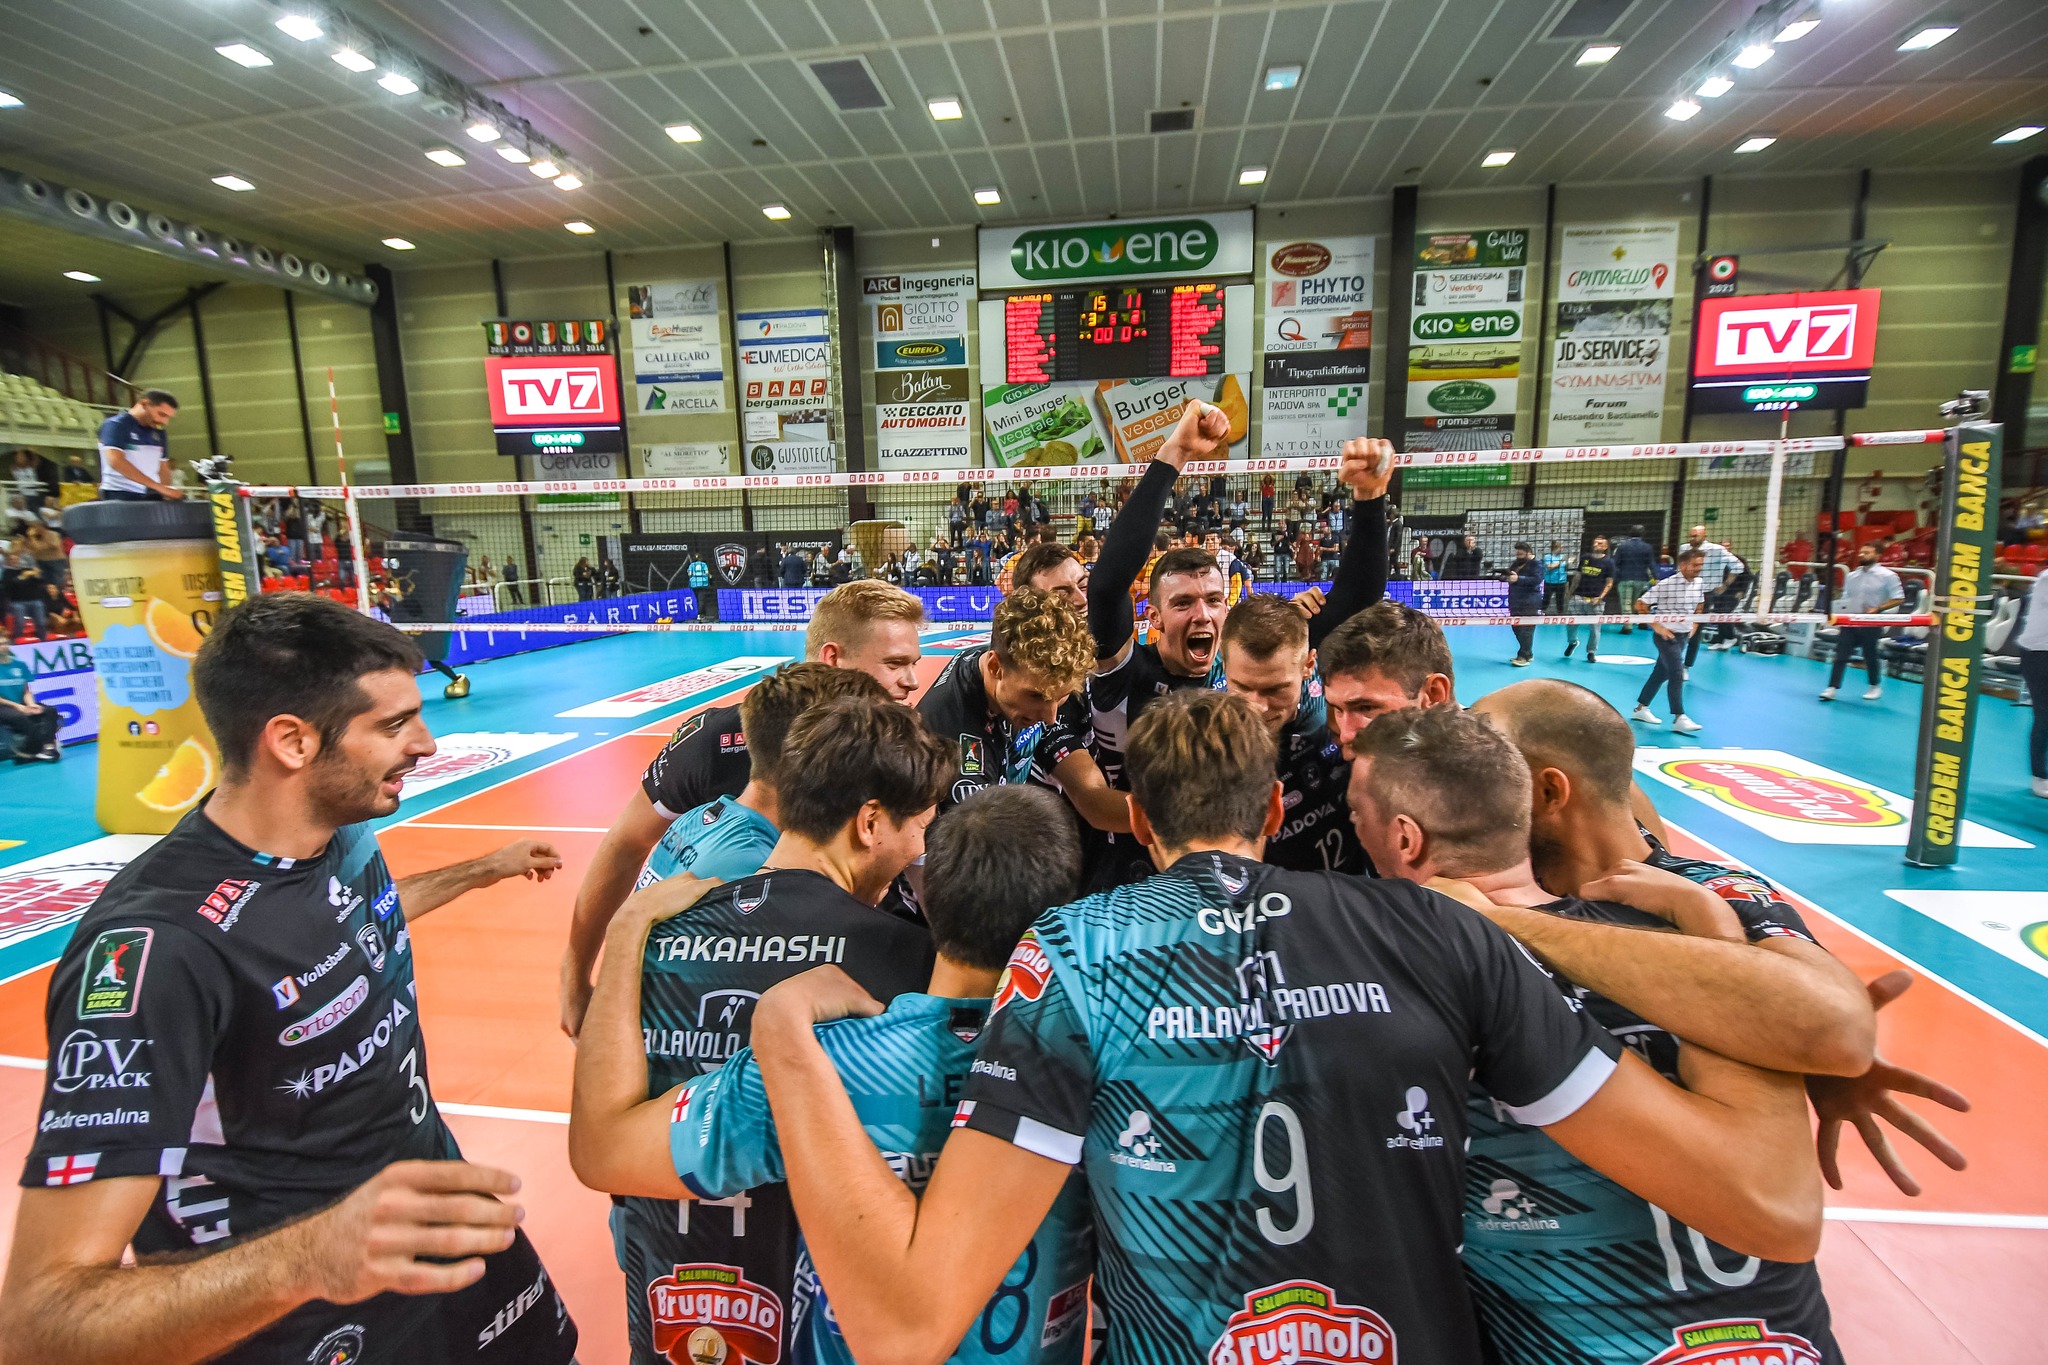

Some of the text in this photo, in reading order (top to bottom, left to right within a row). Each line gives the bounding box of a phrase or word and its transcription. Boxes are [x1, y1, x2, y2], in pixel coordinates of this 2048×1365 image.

[867, 274, 974, 292] ARC ingegneria
[1301, 276, 1365, 295] PHYTO
[1093, 295, 1107, 311] 15
[1127, 292, 1142, 309] 11
[1301, 293, 1365, 305] PERFORMANCE
[903, 301, 959, 316] GIOTTO
[909, 314, 954, 325] CELLINO
[1088, 312, 1097, 327] 3
[1726, 314, 1850, 356] TV7
[586, 344, 606, 352] 2016
[902, 346, 939, 354] EUREKA
[1266, 342, 1318, 351] CONQUEST
[645, 351, 710, 363] CALLEGARO
[748, 347, 827, 365] EUMEDICA
[508, 375, 597, 407] TV7
[747, 379, 827, 398] BAAP
[1269, 388, 1327, 399] INTERPORTO
[671, 398, 719, 409] ARCELLA
[746, 396, 825, 408] bergamaschi
[1114, 381, 1188, 420] Burger
[1269, 401, 1305, 410] PADOVA
[1585, 399, 1628, 408] Forum
[899, 405, 962, 417] CECCATO
[993, 394, 1067, 431] Mini Burger
[1553, 411, 1660, 421] Alessandro Bastianello
[881, 416, 966, 429] AUTOMOBILI
[1122, 403, 1185, 438] vegetal
[1000, 416, 1054, 445] vegetale
[881, 447, 968, 457] IL GAZZETTINO
[1131, 437, 1166, 456] con semi
[1263, 440, 1345, 452] ANTONUC
[643, 480, 676, 488] BAAP
[694, 478, 727, 487] BAAP
[745, 477, 778, 486] BAAP
[797, 475, 831, 484] BAAP
[849, 473, 884, 483] BAAP
[903, 471, 939, 481] BAAP
[958, 470, 995, 480] BAAP
[1014, 468, 1051, 479] BAAP
[1070, 466, 1108, 476] BAAP
[1187, 462, 1227, 473] BAAP
[1247, 459, 1287, 470] BAAP
[1308, 457, 1344, 468] BAA
[1435, 452, 1477, 463] BAAP
[1500, 450, 1543, 462] BAAP
[1565, 448, 1609, 458] BAAP
[212, 493, 243, 563] BANCA
[1440, 597, 1509, 609] TECNO
[1926, 441, 1991, 846] CREDEM BANCA CREDEM BANCA
[720, 733, 745, 747] BA
[1271, 802, 1337, 844] PADOVA
[1315, 828, 1347, 870] 12
[656, 934, 847, 964] TAKAHASHI
[296, 942, 352, 988] Volksbank
[1147, 982, 1392, 1040] PALLAVOL PADOVA
[643, 1027, 741, 1059] ALLAVOLO
[88, 1072, 152, 1089] PACK
[399, 1048, 430, 1126] 3
[48, 1107, 150, 1130] adrenalina
[1109, 1150, 1177, 1174] adrenalina
[1253, 1101, 1315, 1246] 9
[1475, 1217, 1561, 1231] adrenalina
[678, 1270, 736, 1284] SALUMIFICIO
[655, 1285, 776, 1329] Brugnolo
[1254, 1288, 1327, 1314] SALUMIFICIO
[1215, 1316, 1384, 1365] Brugnolo
[1684, 1325, 1761, 1347] SALUMIFICIO
